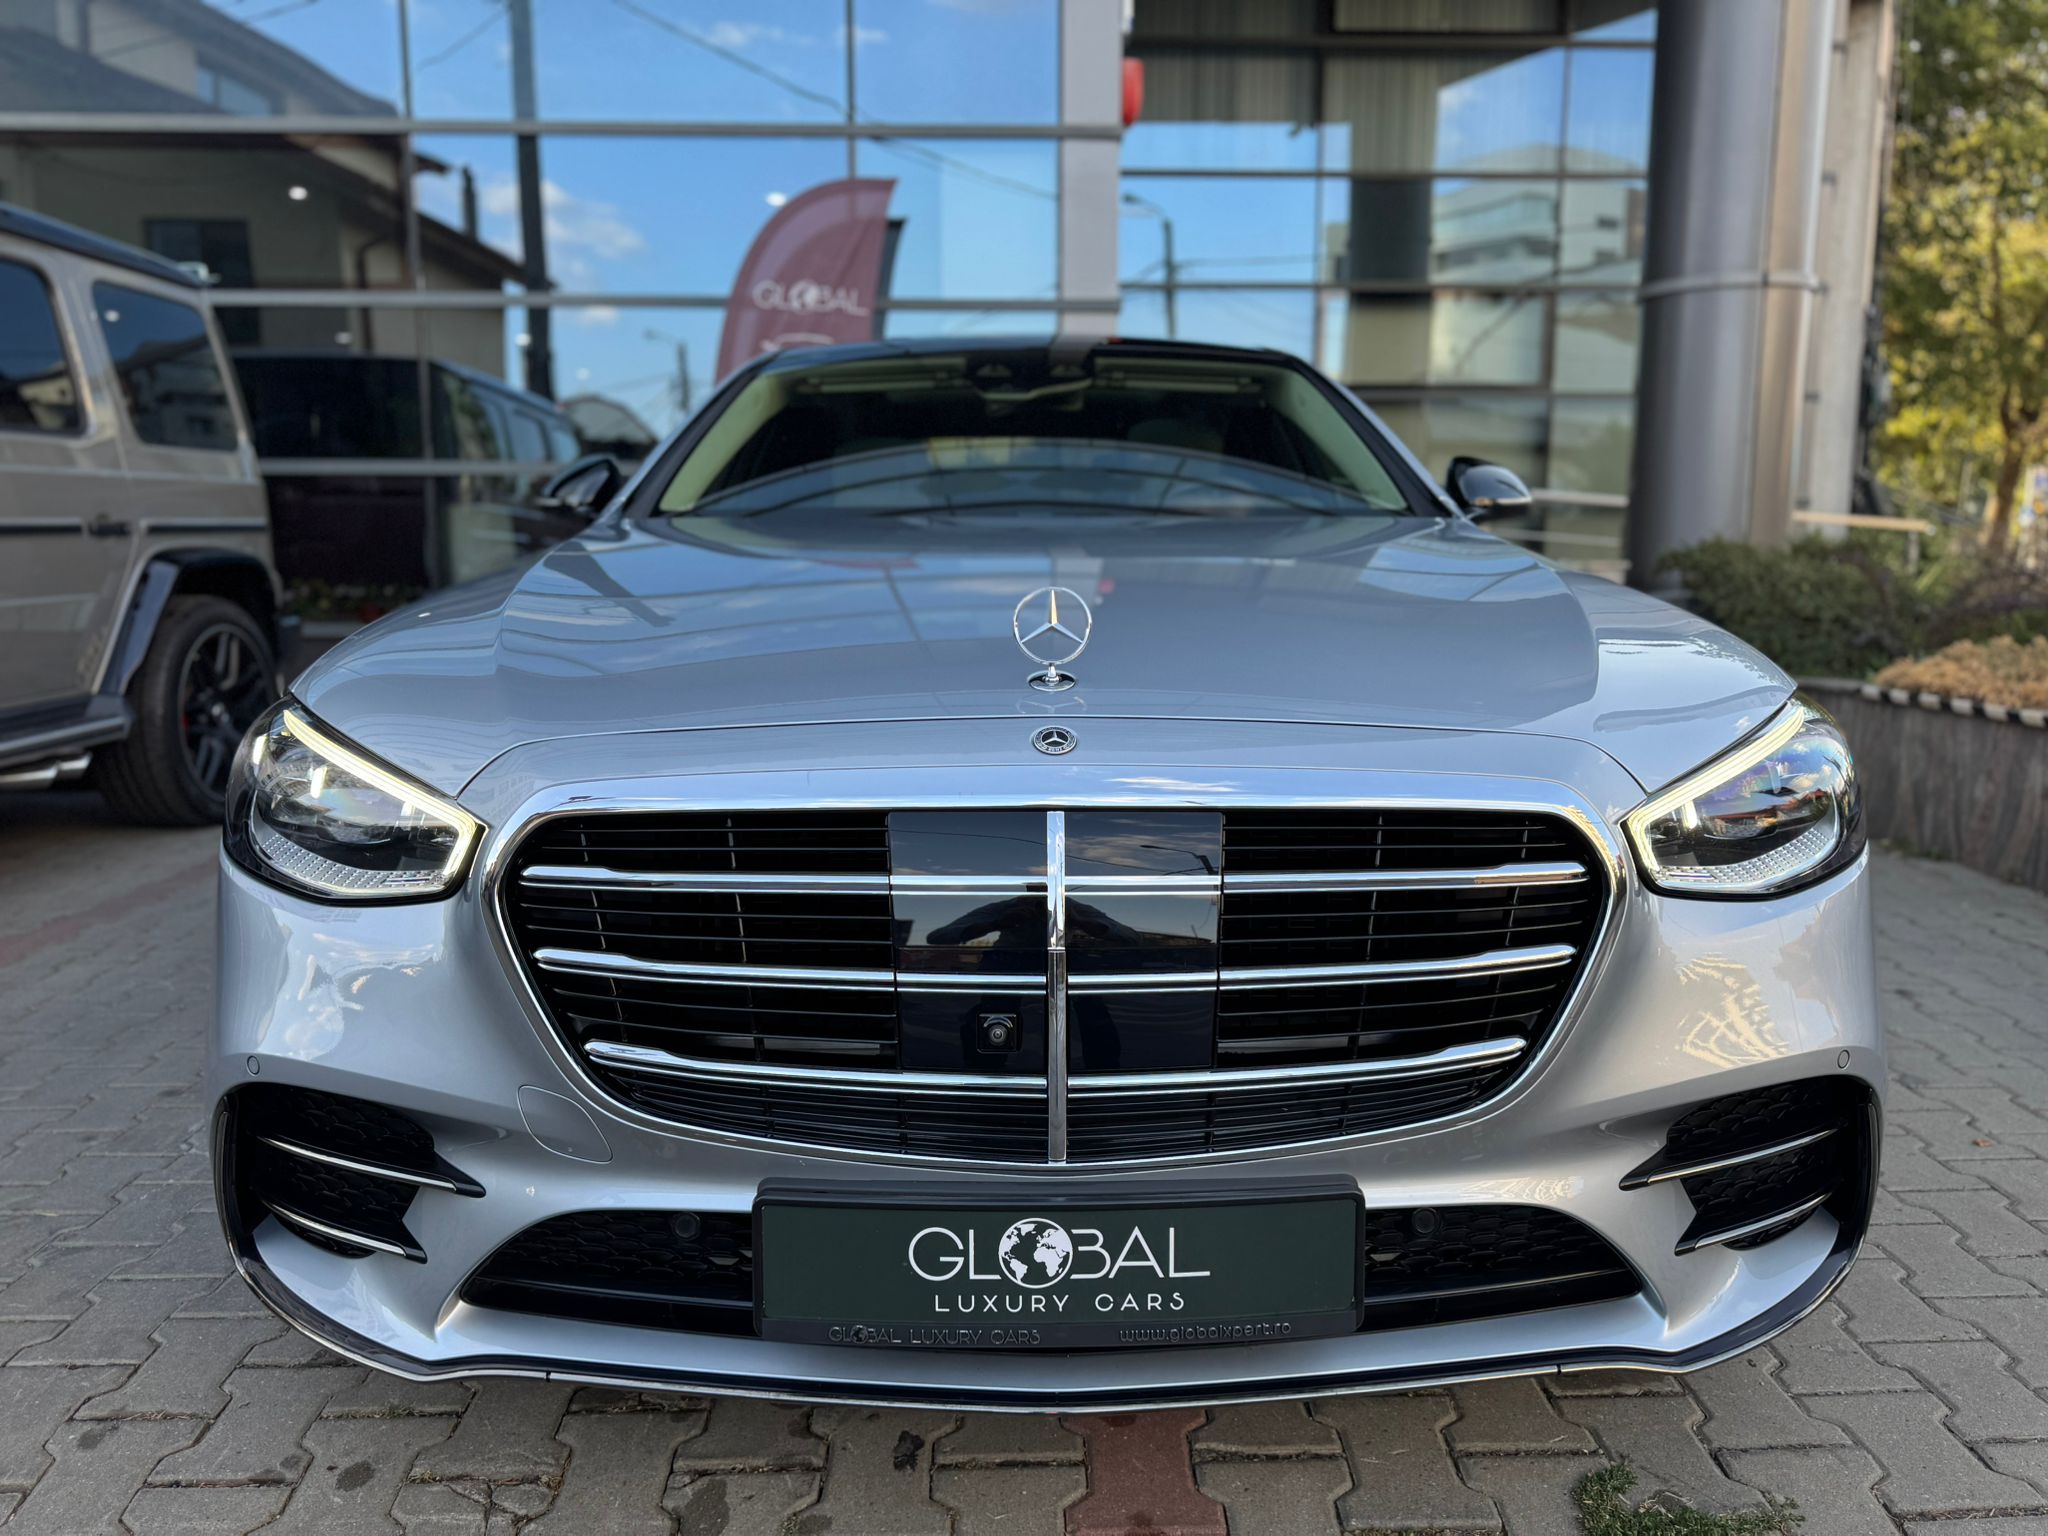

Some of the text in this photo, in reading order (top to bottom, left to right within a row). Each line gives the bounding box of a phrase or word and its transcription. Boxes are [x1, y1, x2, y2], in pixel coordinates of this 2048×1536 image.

[752, 279, 870, 317] GLOBAL
[908, 1217, 1211, 1289] GLOBAL
[934, 1291, 1185, 1313] LUXURY CARS
[827, 1324, 1042, 1345] GLOBAL LUXURY CARS
[1119, 1322, 1292, 1343] www.globalxpert.ro
